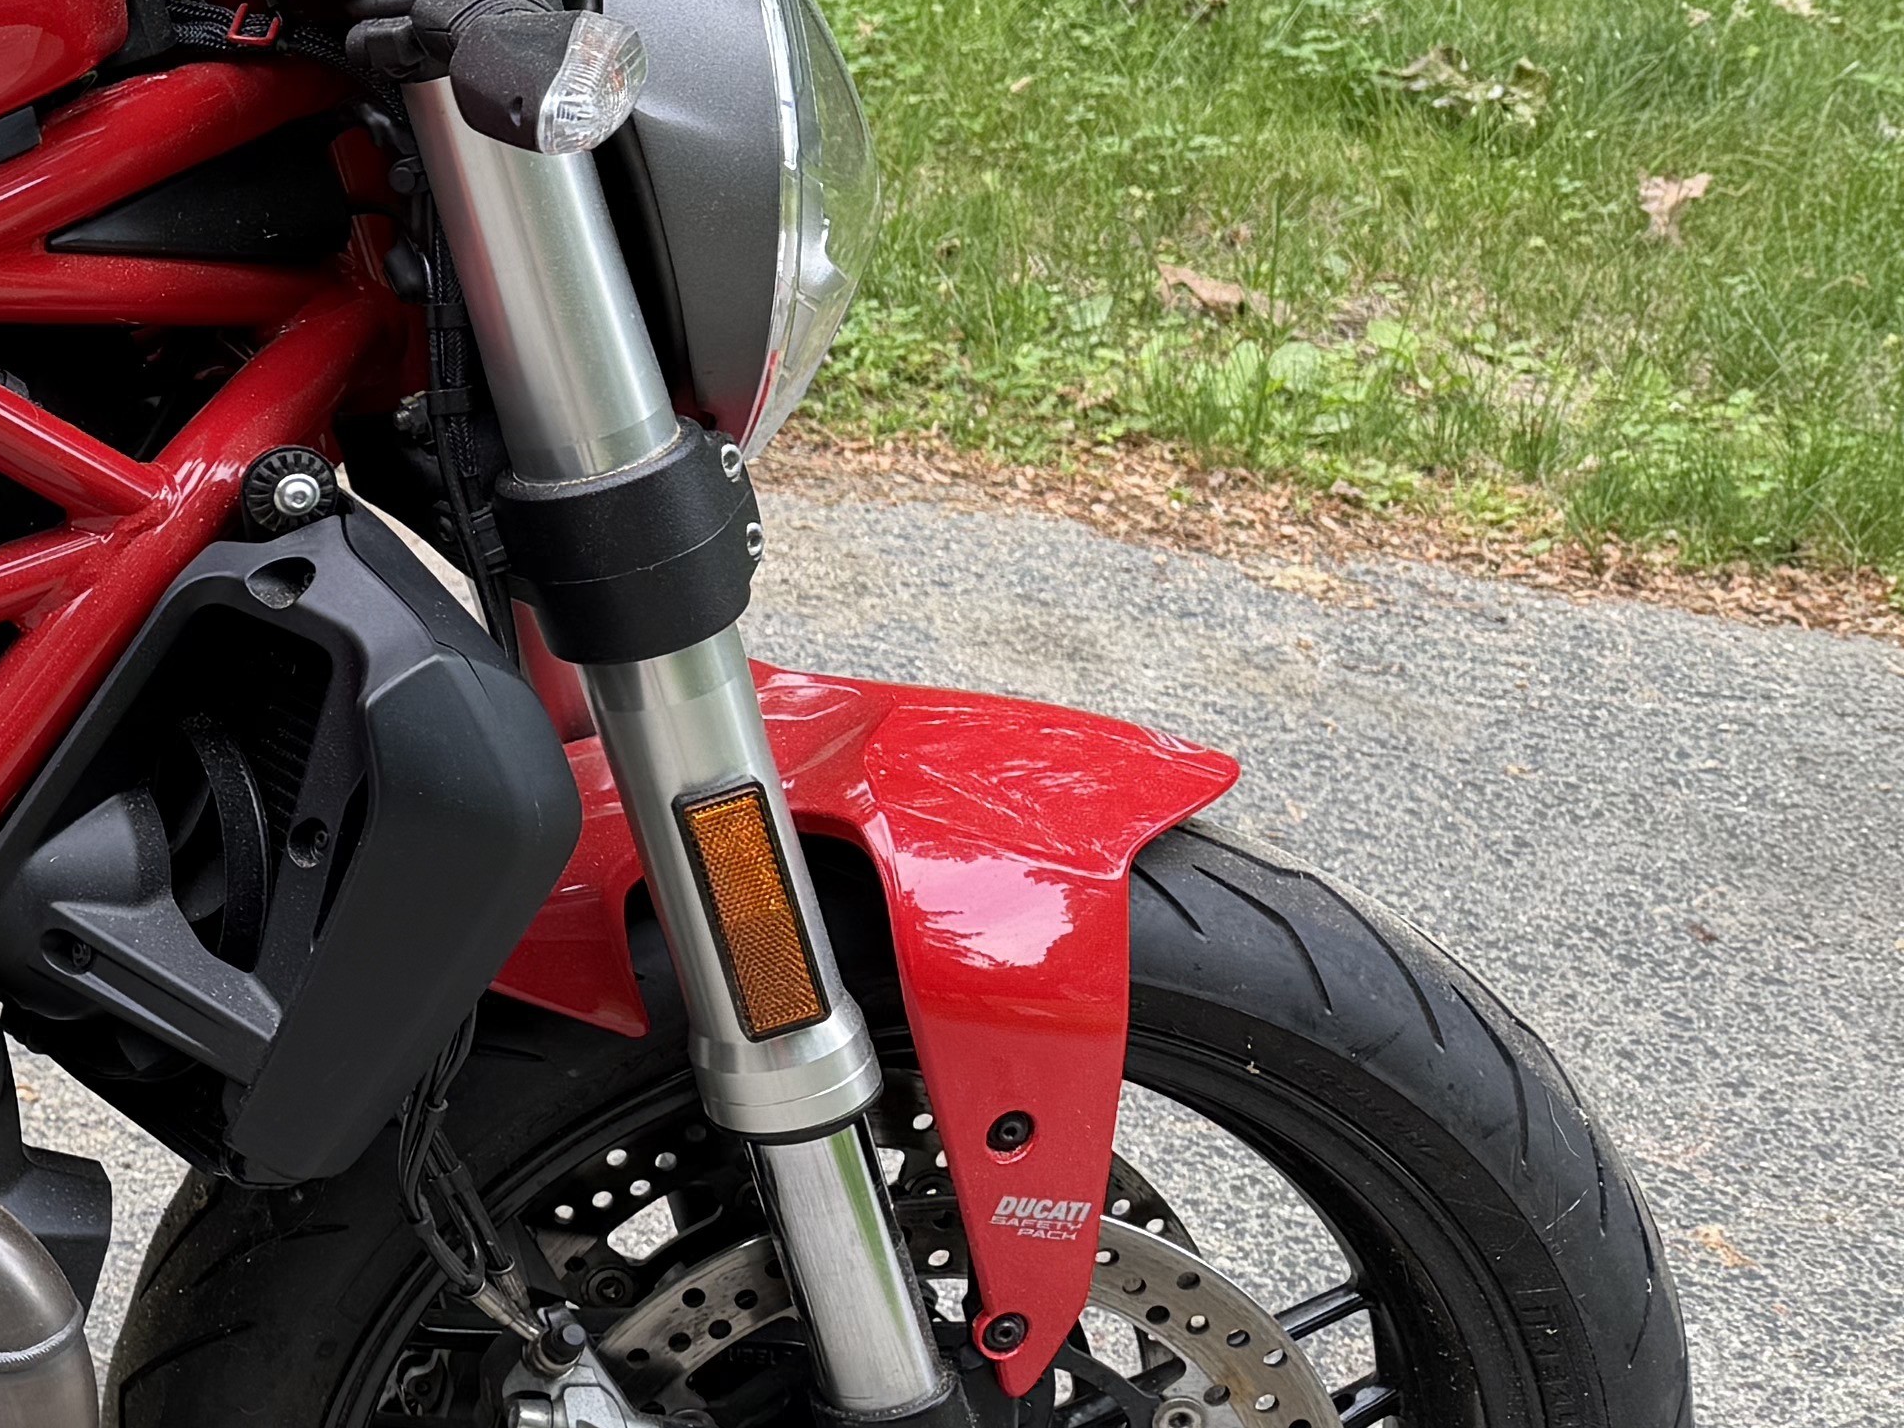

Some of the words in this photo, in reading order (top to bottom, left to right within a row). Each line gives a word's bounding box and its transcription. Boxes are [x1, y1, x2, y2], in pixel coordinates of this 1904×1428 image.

[995, 1195, 1092, 1222] DUCATI
[988, 1215, 1083, 1231] SAFETY
[1017, 1227, 1077, 1241] PACK
